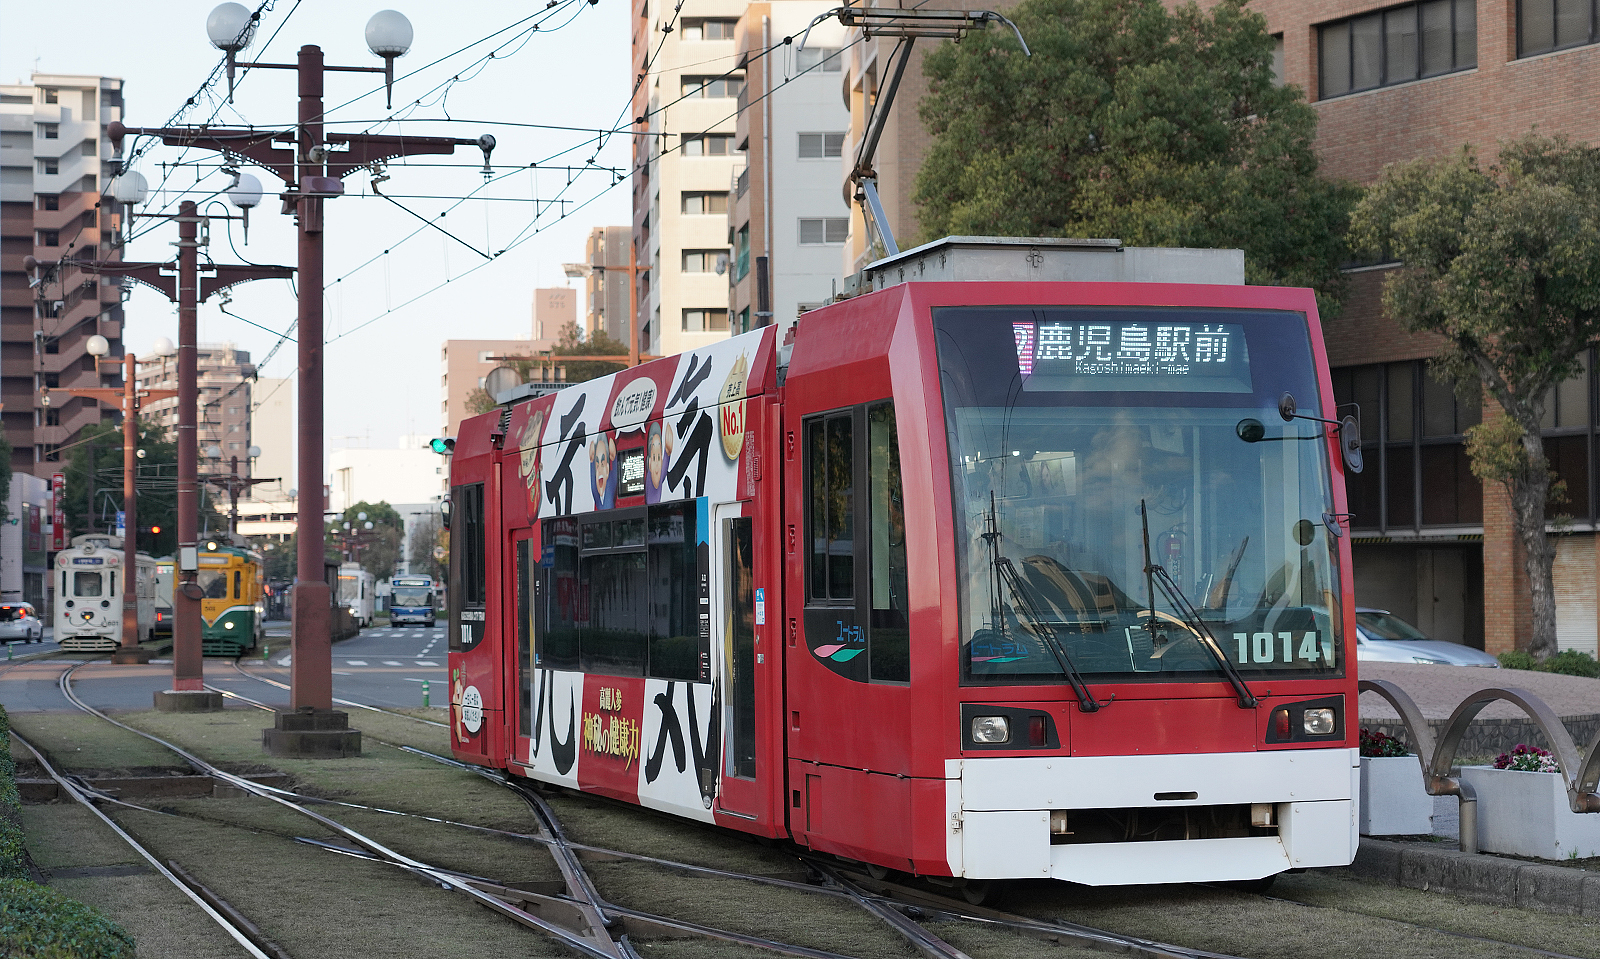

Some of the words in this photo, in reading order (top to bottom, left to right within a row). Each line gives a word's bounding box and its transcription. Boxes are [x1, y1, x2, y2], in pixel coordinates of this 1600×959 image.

[1036, 322, 1230, 363] 鹿児島駅前
[723, 401, 743, 436] No.1
[836, 620, 865, 643] ユートラム
[1232, 632, 1320, 664] 1014
[583, 712, 640, 771] 神秘の健康力
